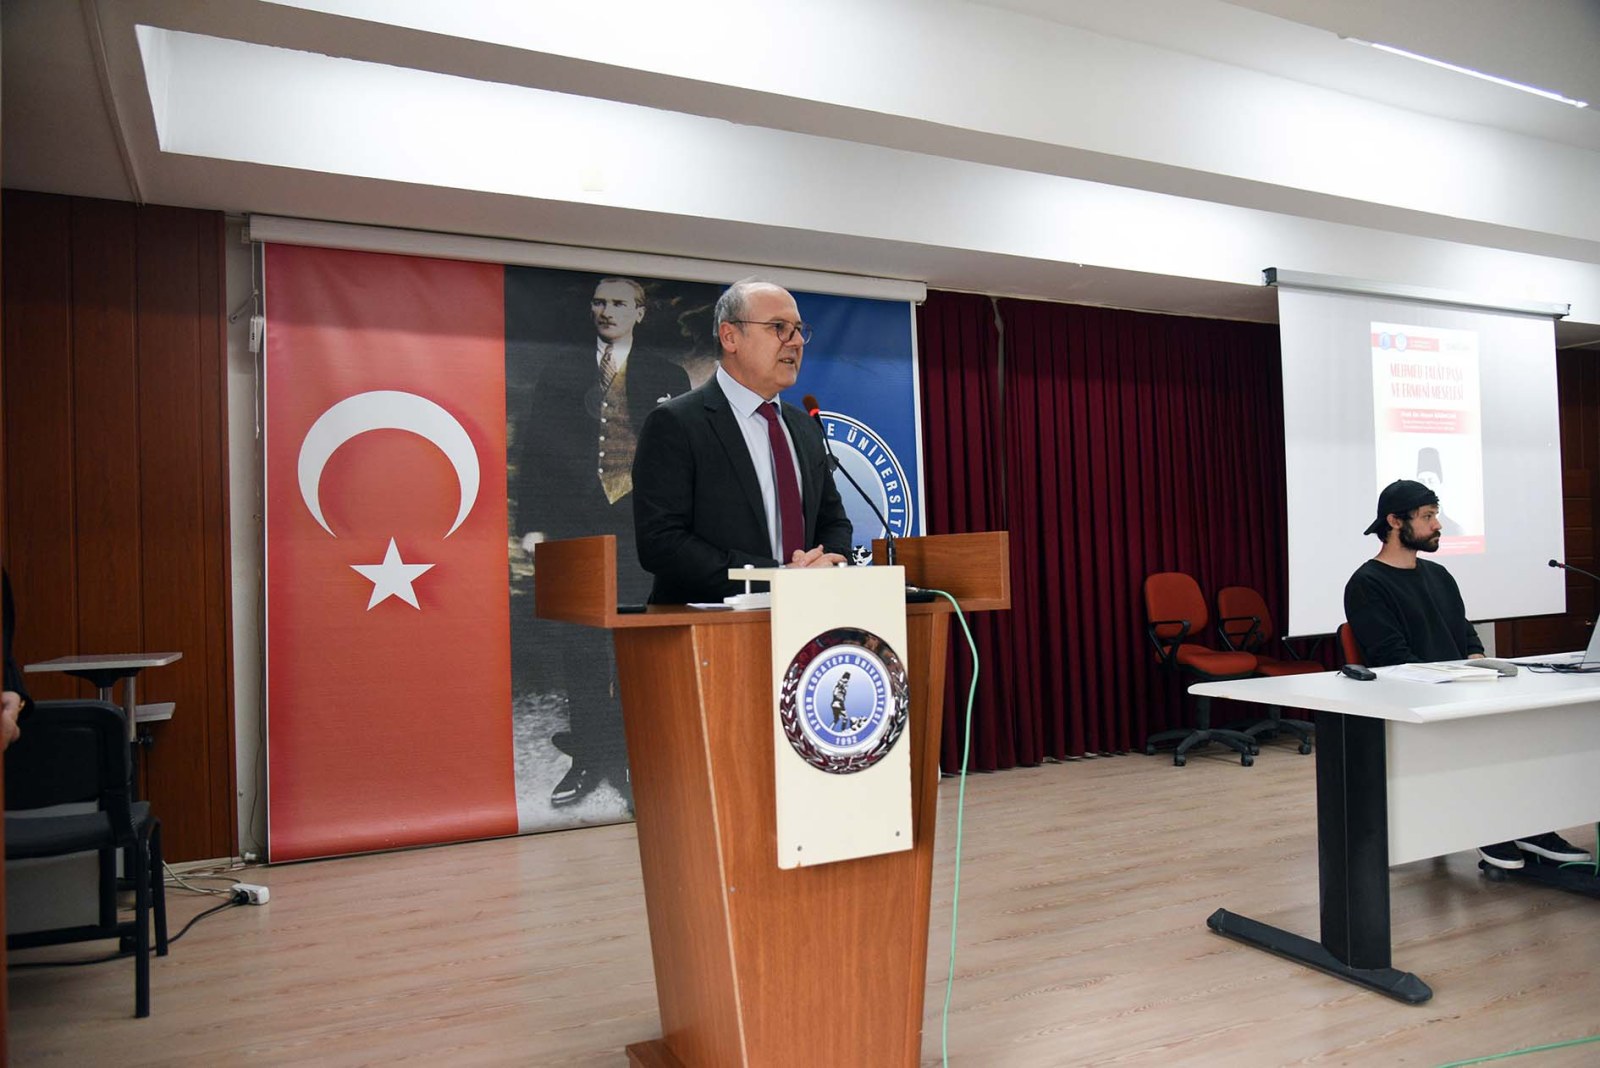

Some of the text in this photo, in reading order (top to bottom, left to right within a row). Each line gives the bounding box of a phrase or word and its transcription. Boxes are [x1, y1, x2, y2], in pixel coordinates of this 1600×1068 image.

[811, 655, 850, 691] KOCATEPE
[806, 697, 821, 731] AFYON
[835, 735, 857, 746] 1992
